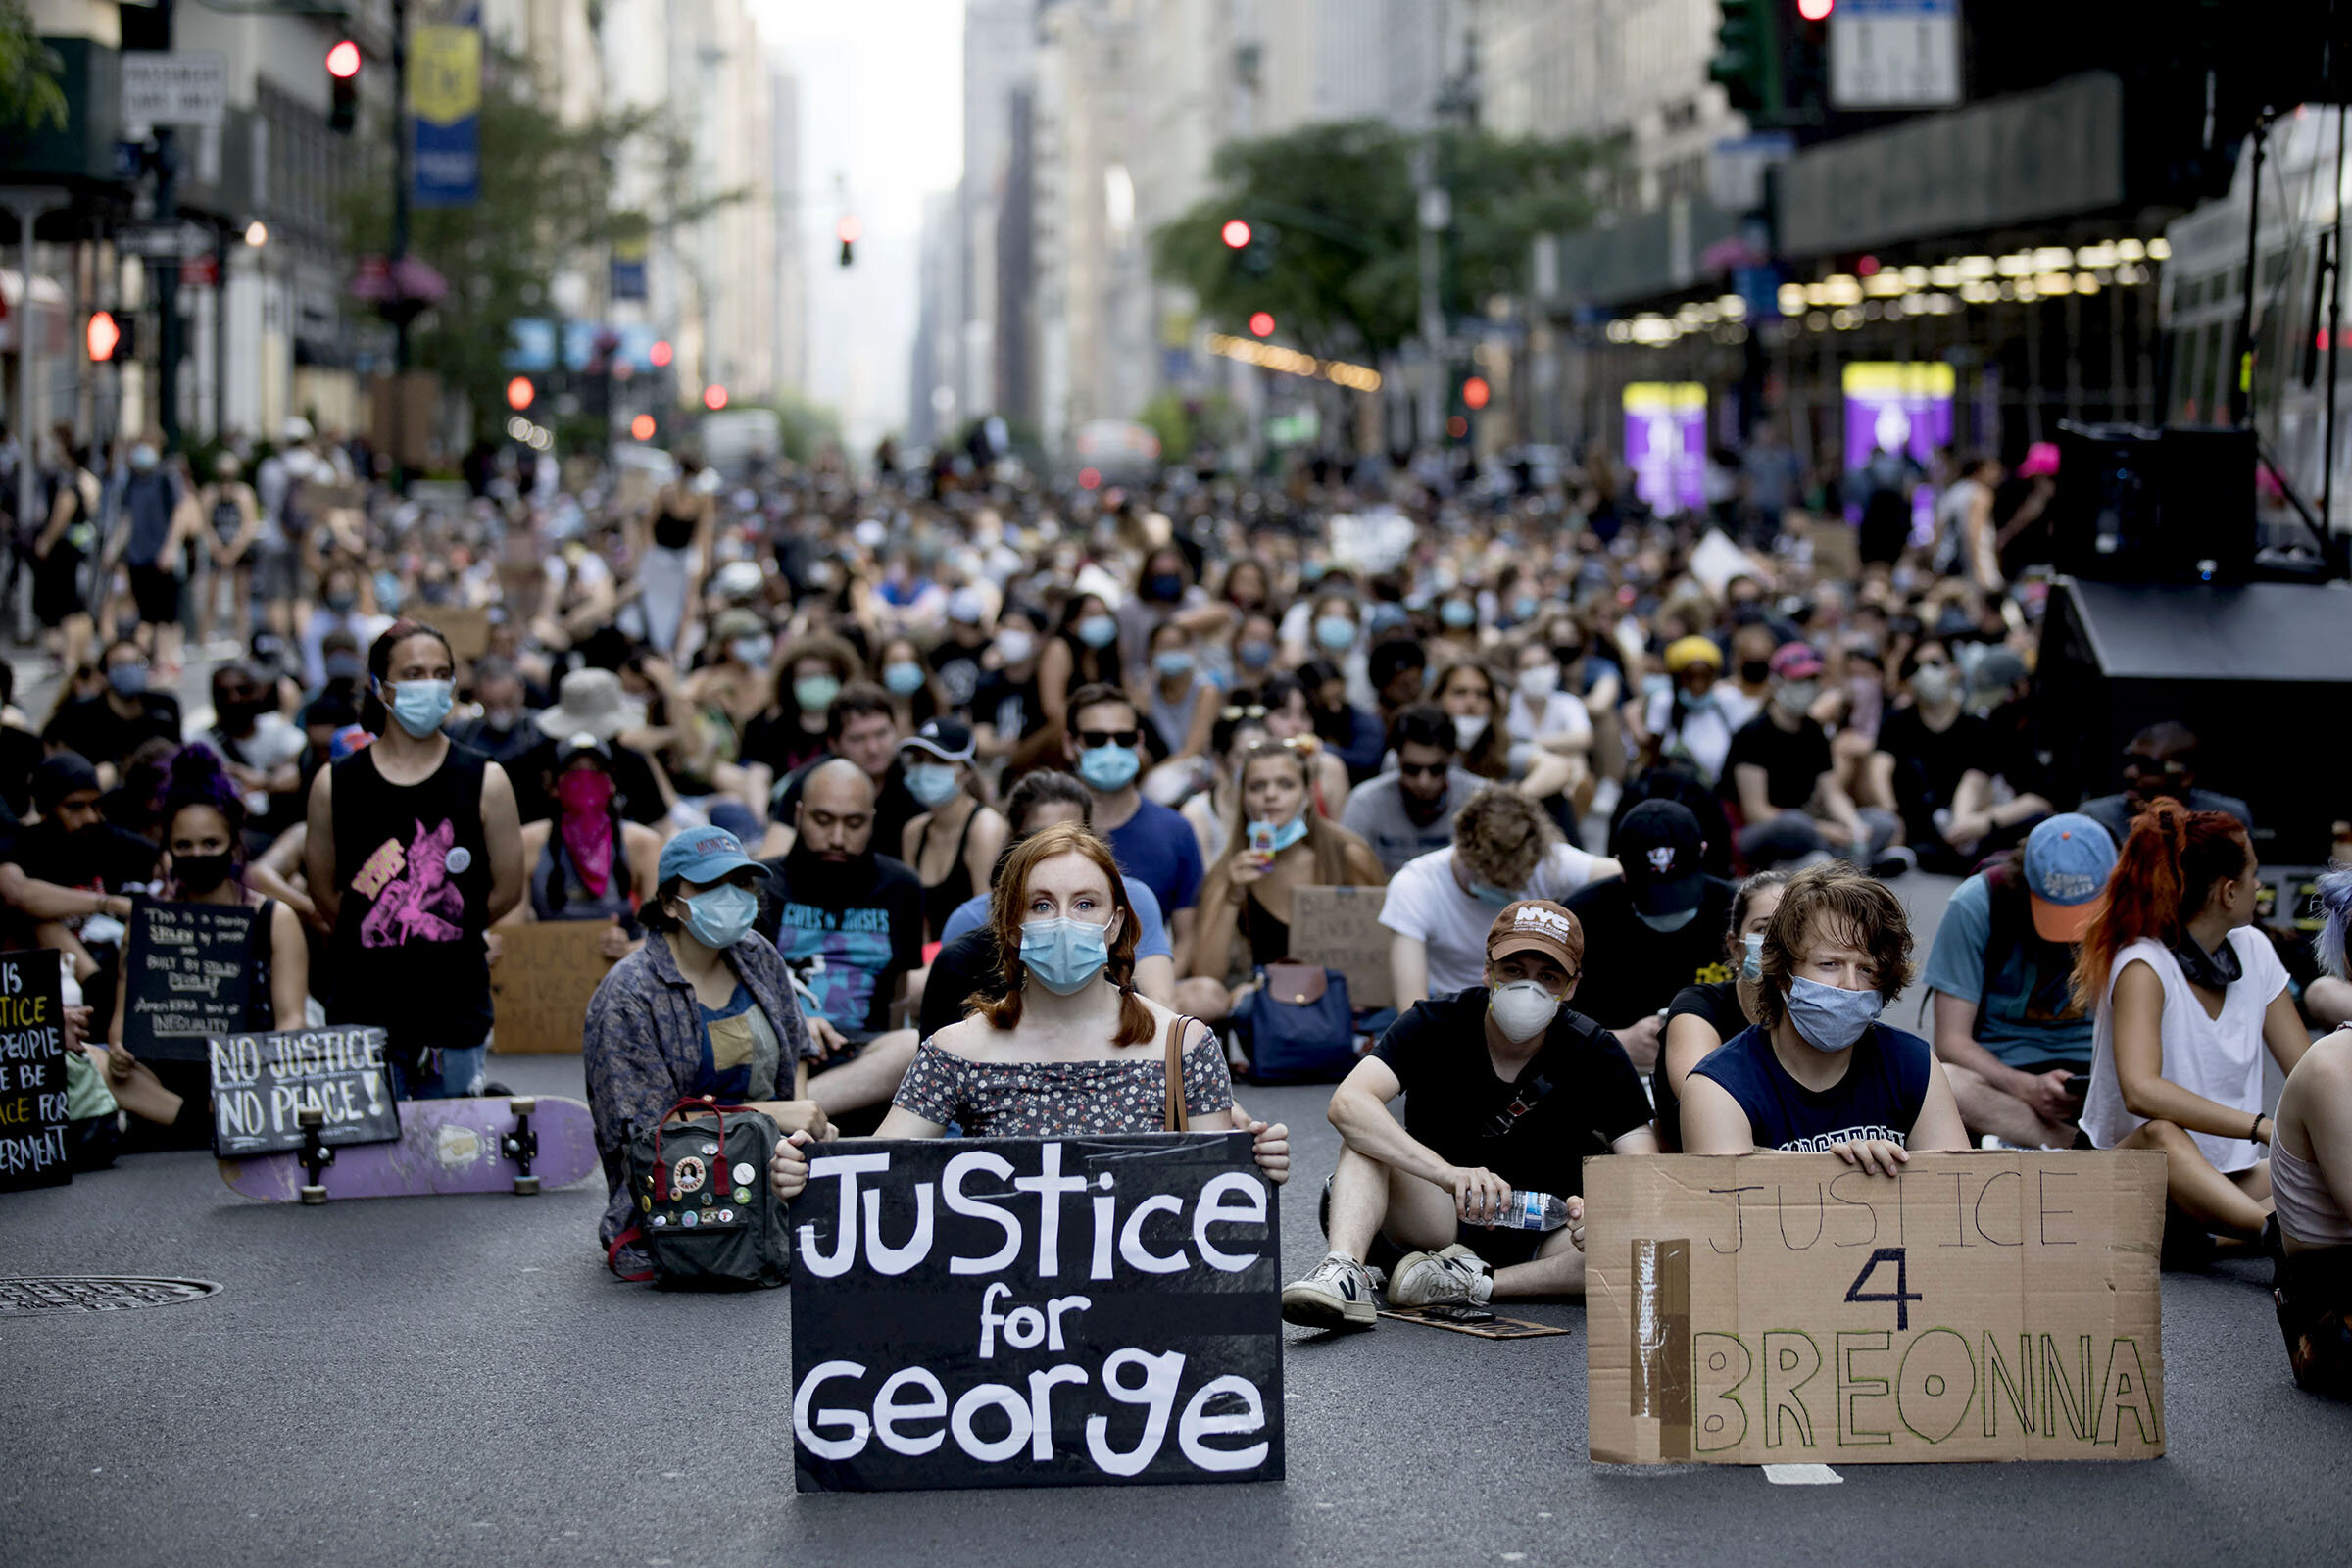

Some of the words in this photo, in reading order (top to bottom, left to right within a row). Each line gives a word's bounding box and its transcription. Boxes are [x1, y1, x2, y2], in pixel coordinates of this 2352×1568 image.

[1515, 906, 1570, 931] NYC
[2, 962, 23, 995] IS
[0, 996, 47, 1027] TICE
[19, 1064, 46, 1090] BE
[211, 1036, 261, 1083] NO
[267, 1028, 385, 1079] JUSTICE
[39, 1092, 70, 1123] FOR
[219, 1089, 265, 1136] NO
[1709, 1170, 2078, 1254] JUSTICE
[1844, 1248, 1923, 1331] 4
[980, 1282, 1092, 1359] for
[793, 1347, 1269, 1477] George
[1693, 1327, 2160, 1452] BREONNA
